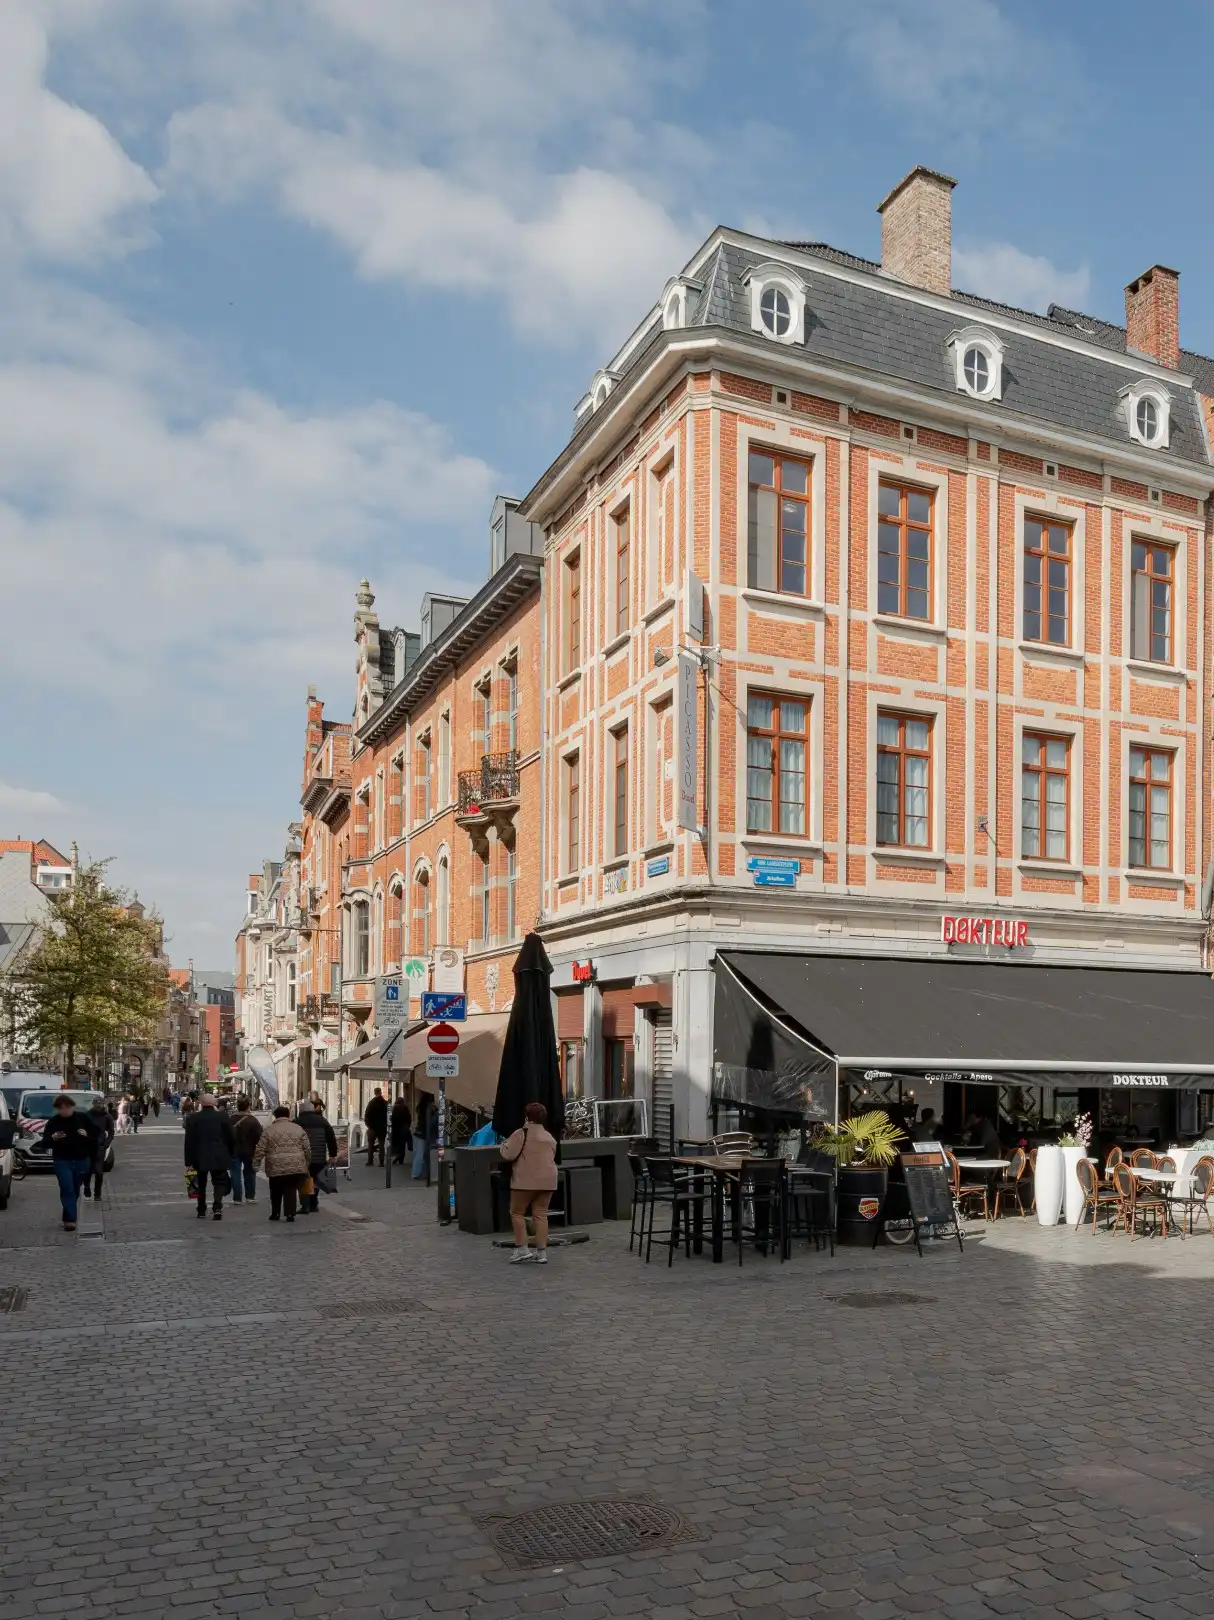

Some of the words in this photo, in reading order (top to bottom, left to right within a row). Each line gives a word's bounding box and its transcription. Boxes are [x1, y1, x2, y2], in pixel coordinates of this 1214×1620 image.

[684, 664, 693, 787] PICASSO
[263, 989, 273, 1031] DAMART
[1112, 1074, 1169, 1086] DOKTEUR
